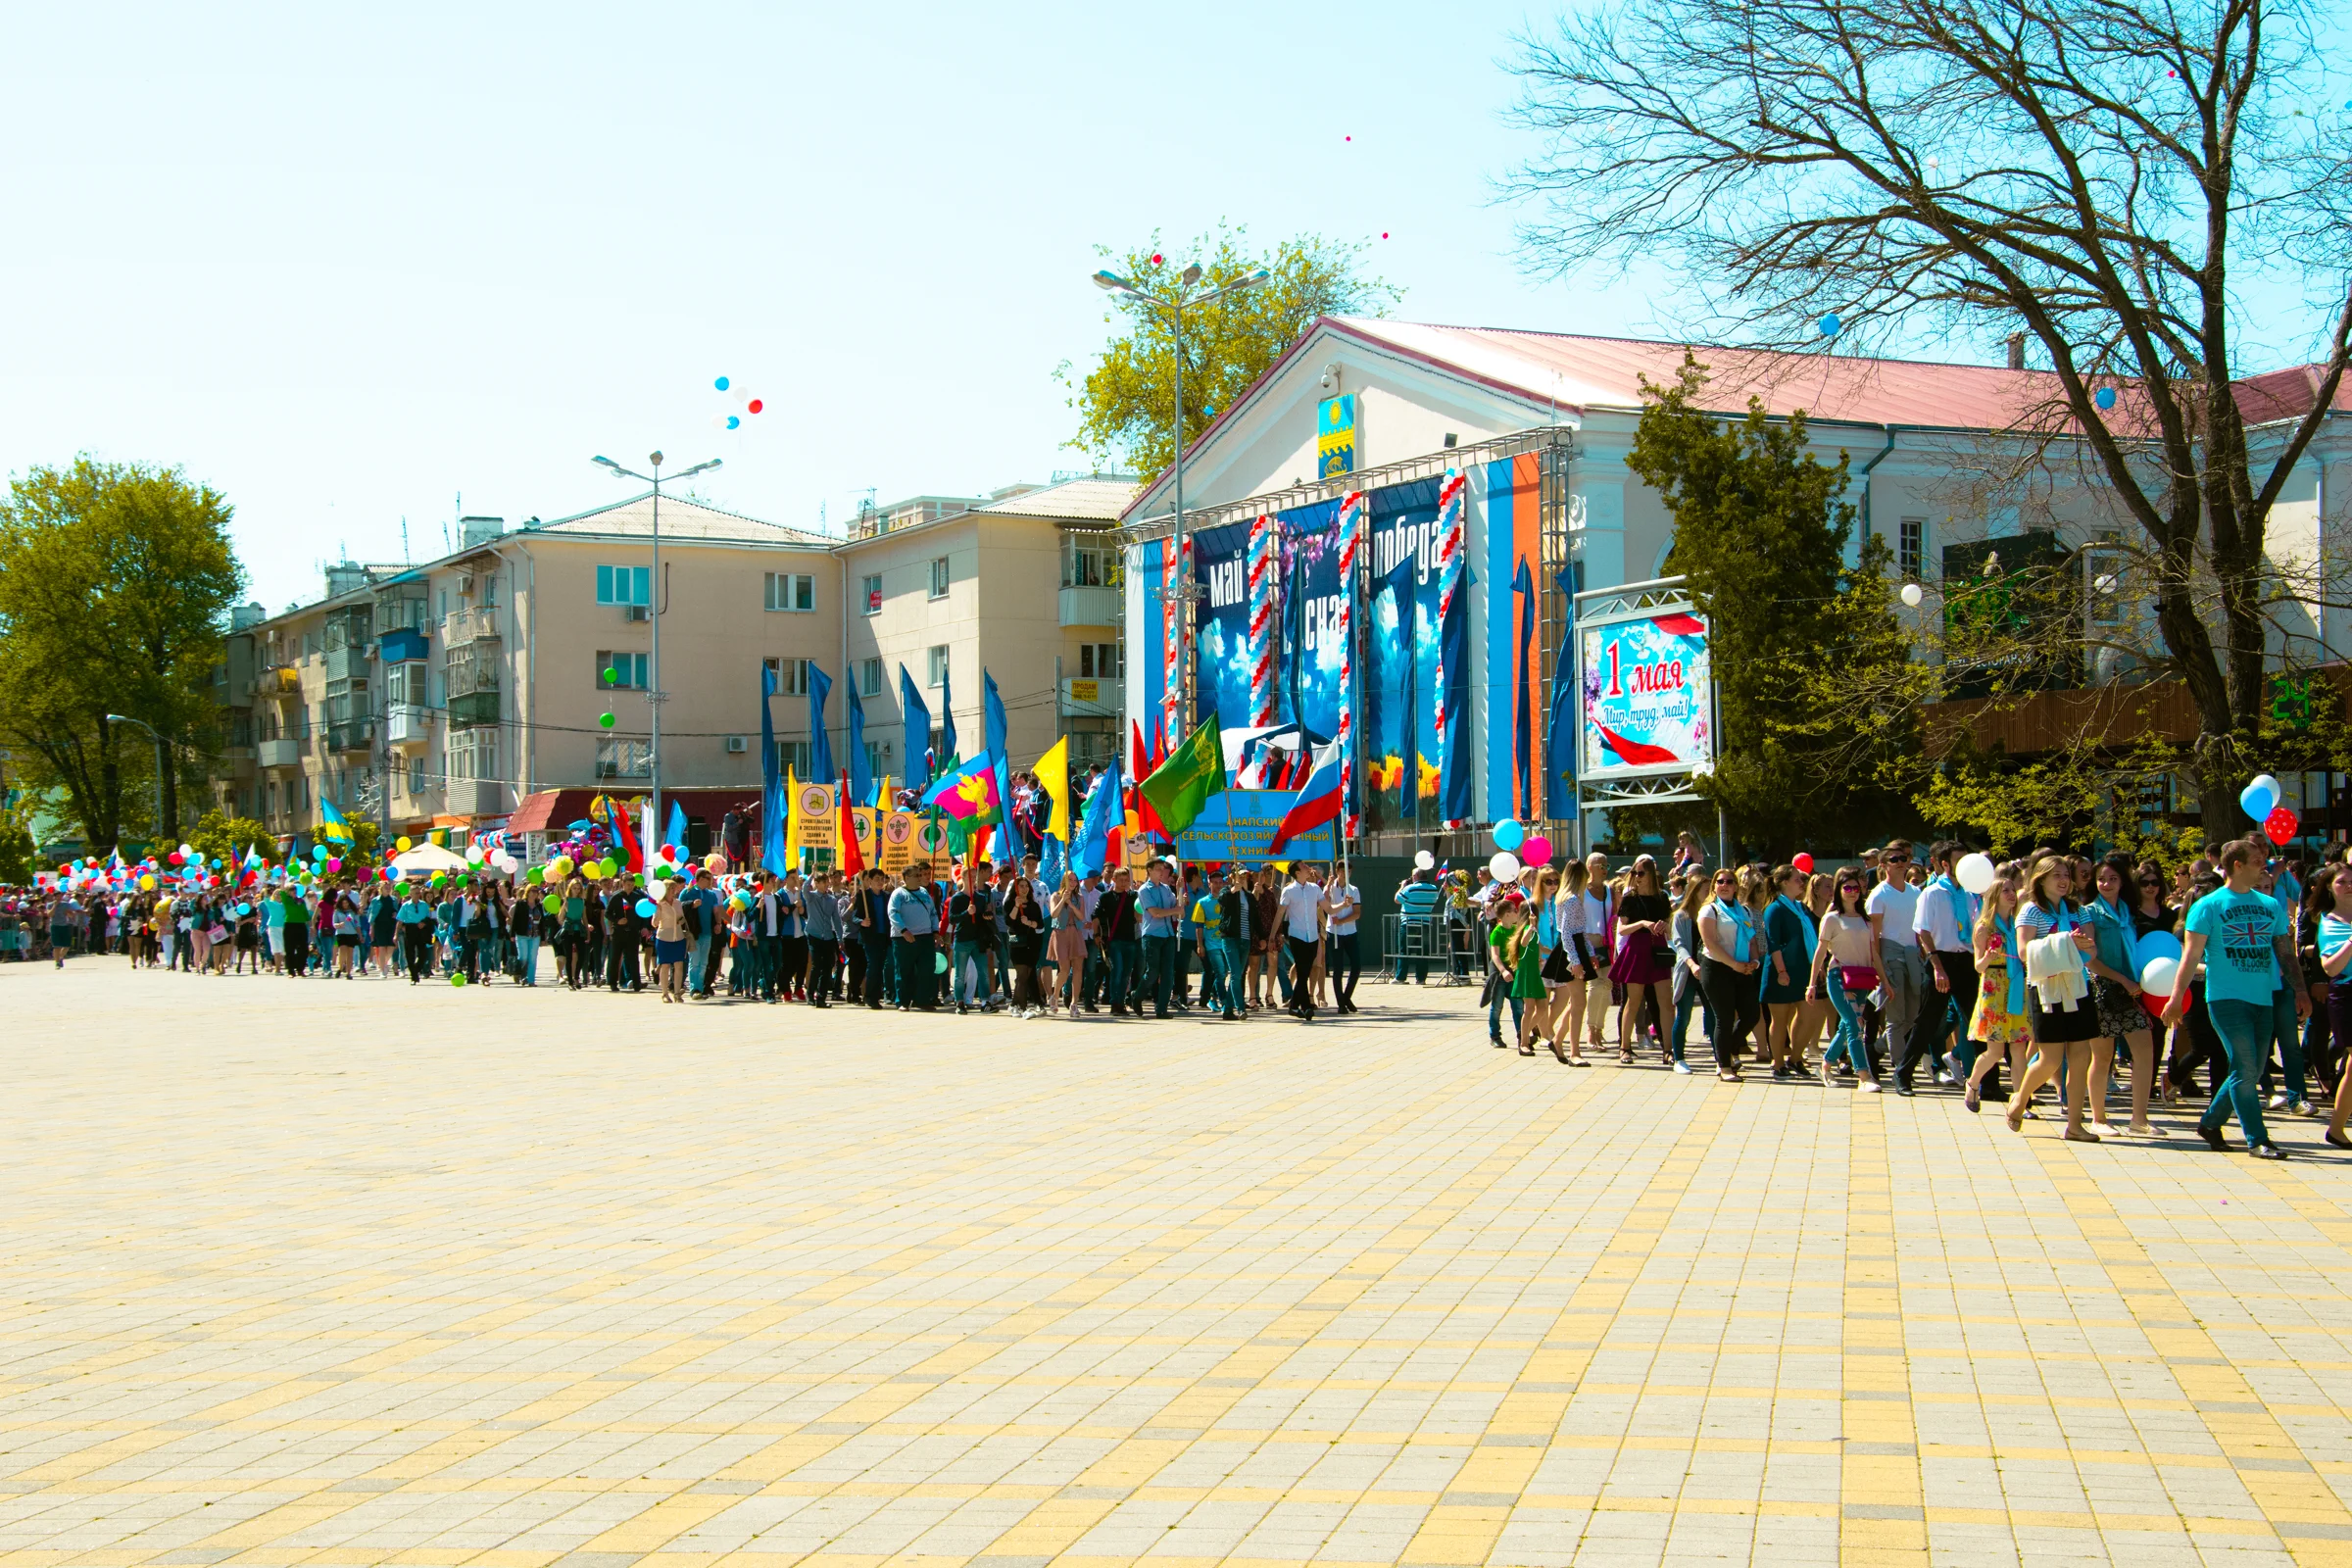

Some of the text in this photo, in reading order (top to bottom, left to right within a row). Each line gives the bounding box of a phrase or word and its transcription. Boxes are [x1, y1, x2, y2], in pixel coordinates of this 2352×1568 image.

[1209, 549, 1244, 609] май
[1608, 641, 1685, 696] 1 мая
[1602, 699, 1689, 729] Мир, труд, май!
[2273, 677, 2310, 718] 24
[1226, 815, 1286, 827] АНАПСКИЙ
[1228, 846, 1287, 856] ТЕХНИК
